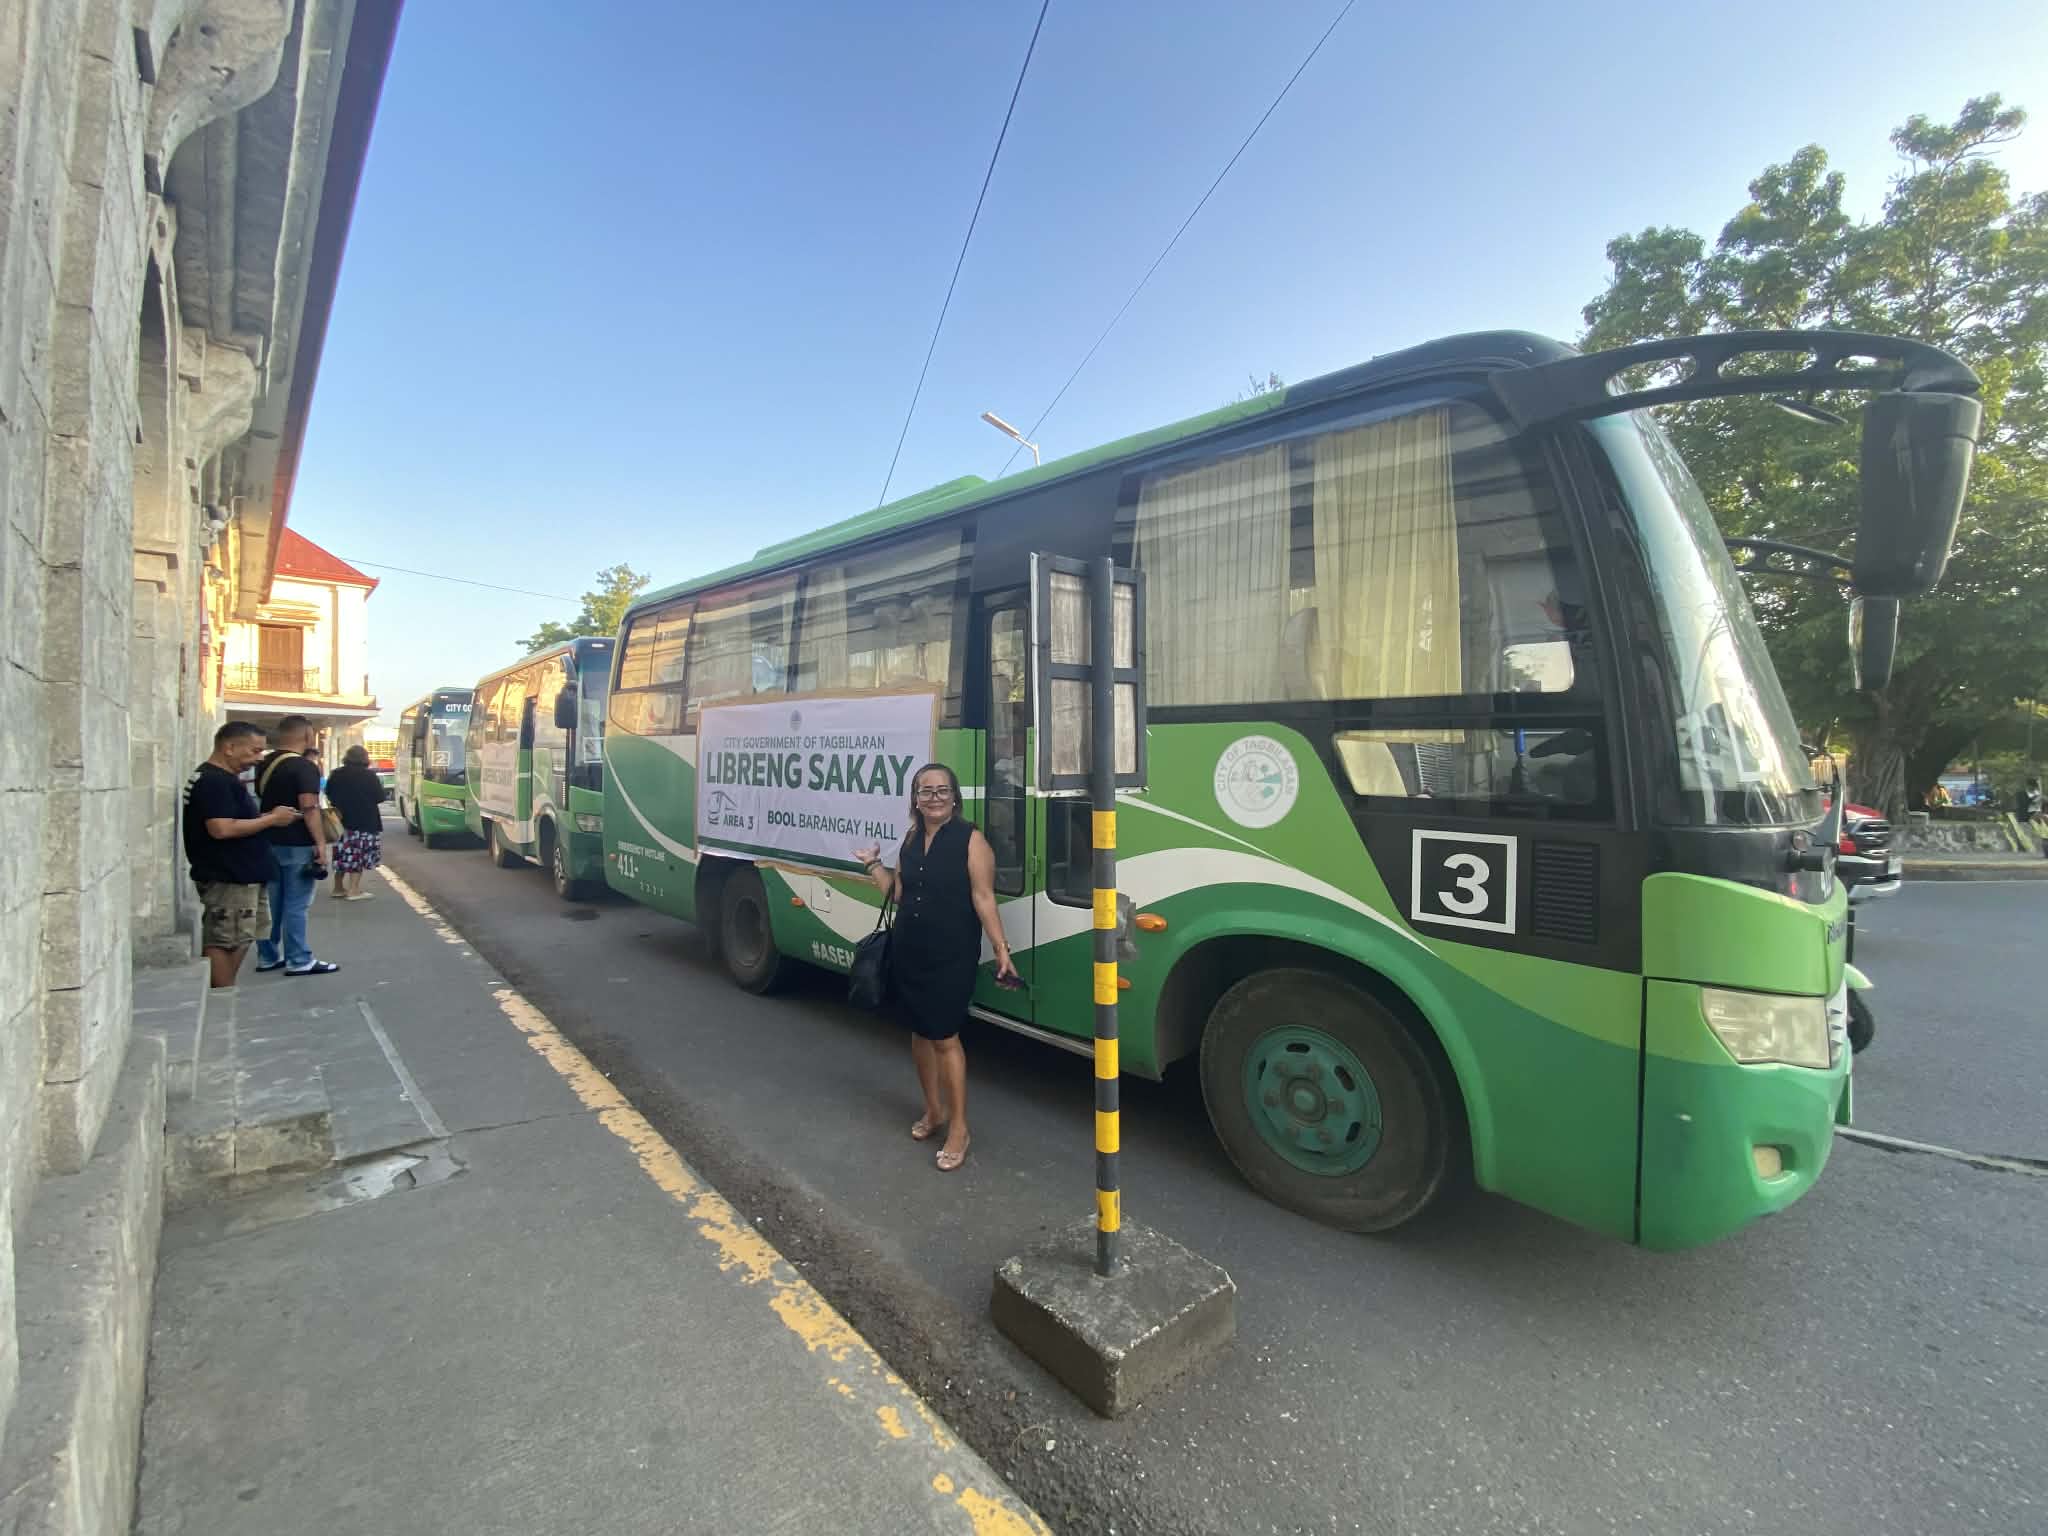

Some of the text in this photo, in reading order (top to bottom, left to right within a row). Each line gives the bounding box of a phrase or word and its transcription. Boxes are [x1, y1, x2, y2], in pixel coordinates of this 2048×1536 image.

[445, 703, 462, 713] CITY
[723, 735, 885, 751] CITY GOVERNMENT OF TAGBILARAN
[706, 751, 914, 797] LIBRENG SAKAY
[1217, 762, 1228, 792] CITY
[1226, 745, 1241, 761] OF
[723, 814, 754, 830] AREA 3
[767, 810, 898, 841] BOOL BARANGAY HALL
[1439, 853, 1490, 915] 3
